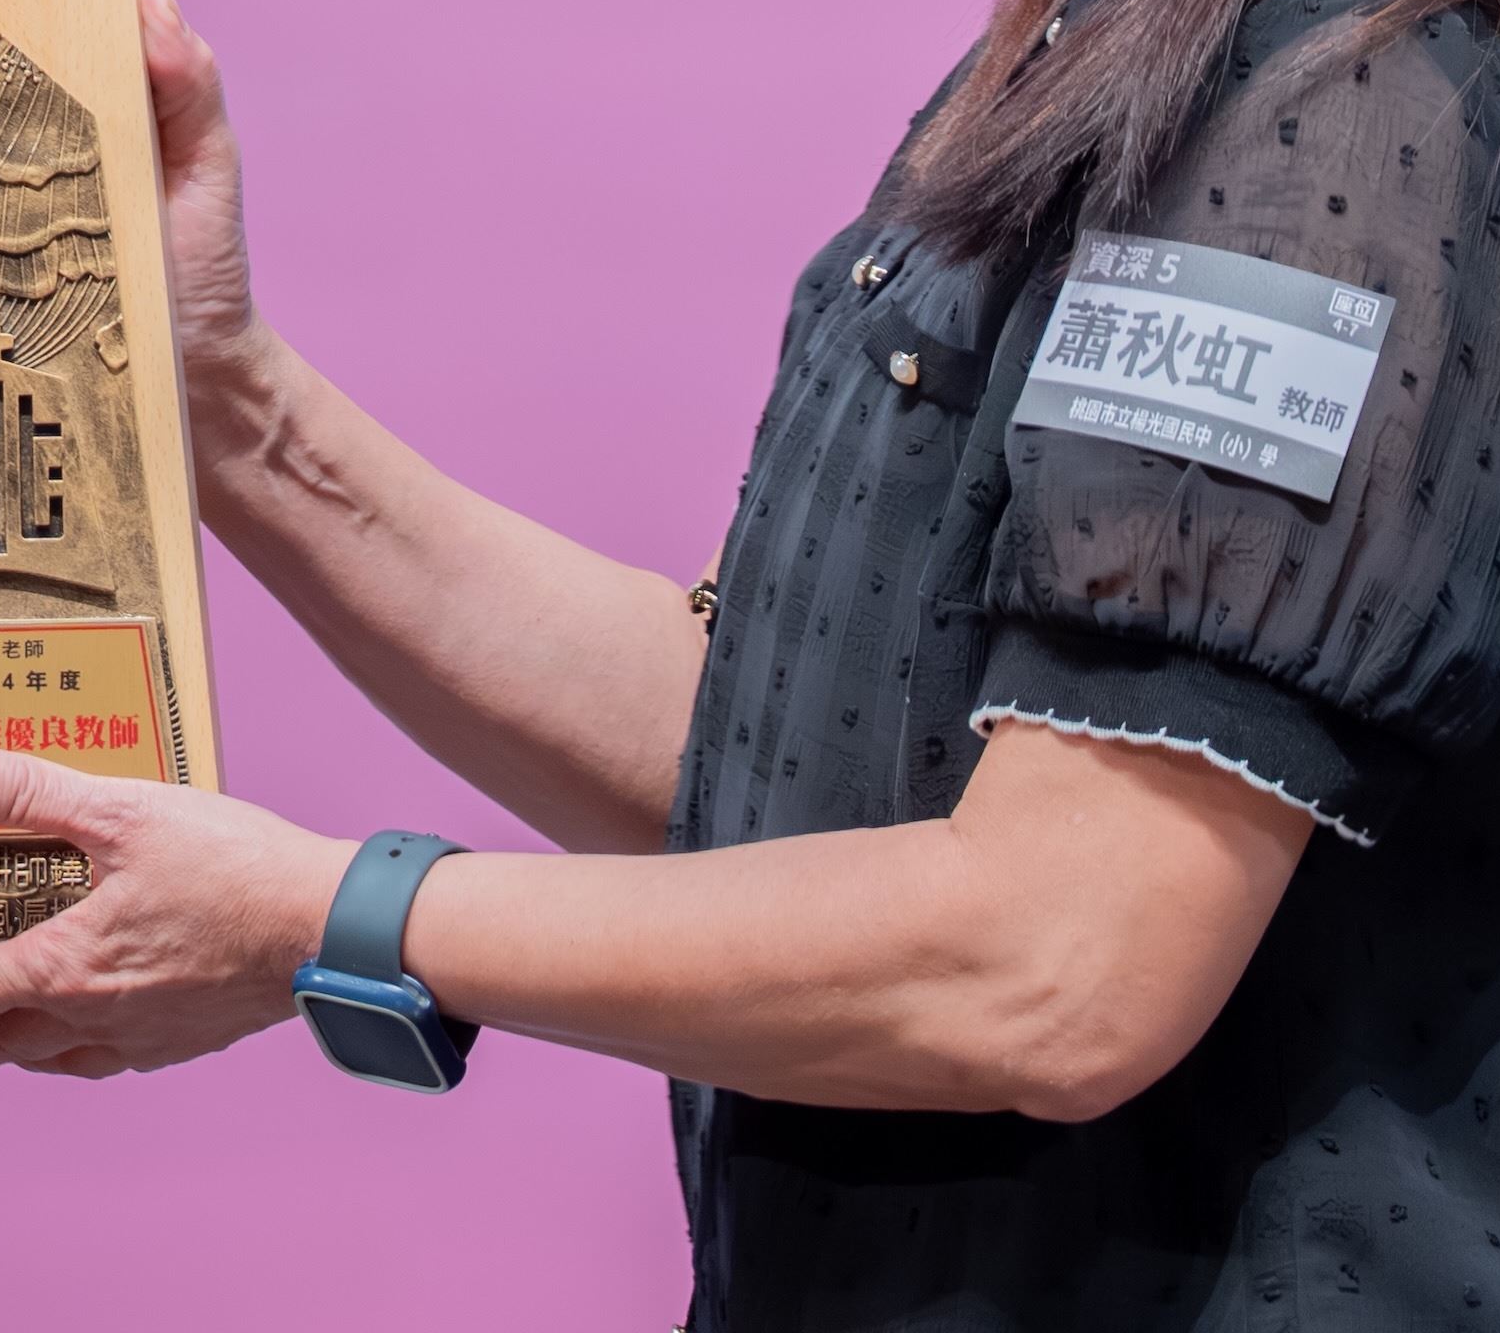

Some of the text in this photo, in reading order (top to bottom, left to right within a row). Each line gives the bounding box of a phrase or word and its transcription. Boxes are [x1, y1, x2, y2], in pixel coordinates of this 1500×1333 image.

[1334, 294, 1373, 321] 座位
[1333, 318, 1359, 337] 4-7
[1046, 298, 1348, 434] 蕭秋虹 教師
[2, 639, 44, 659] 老師
